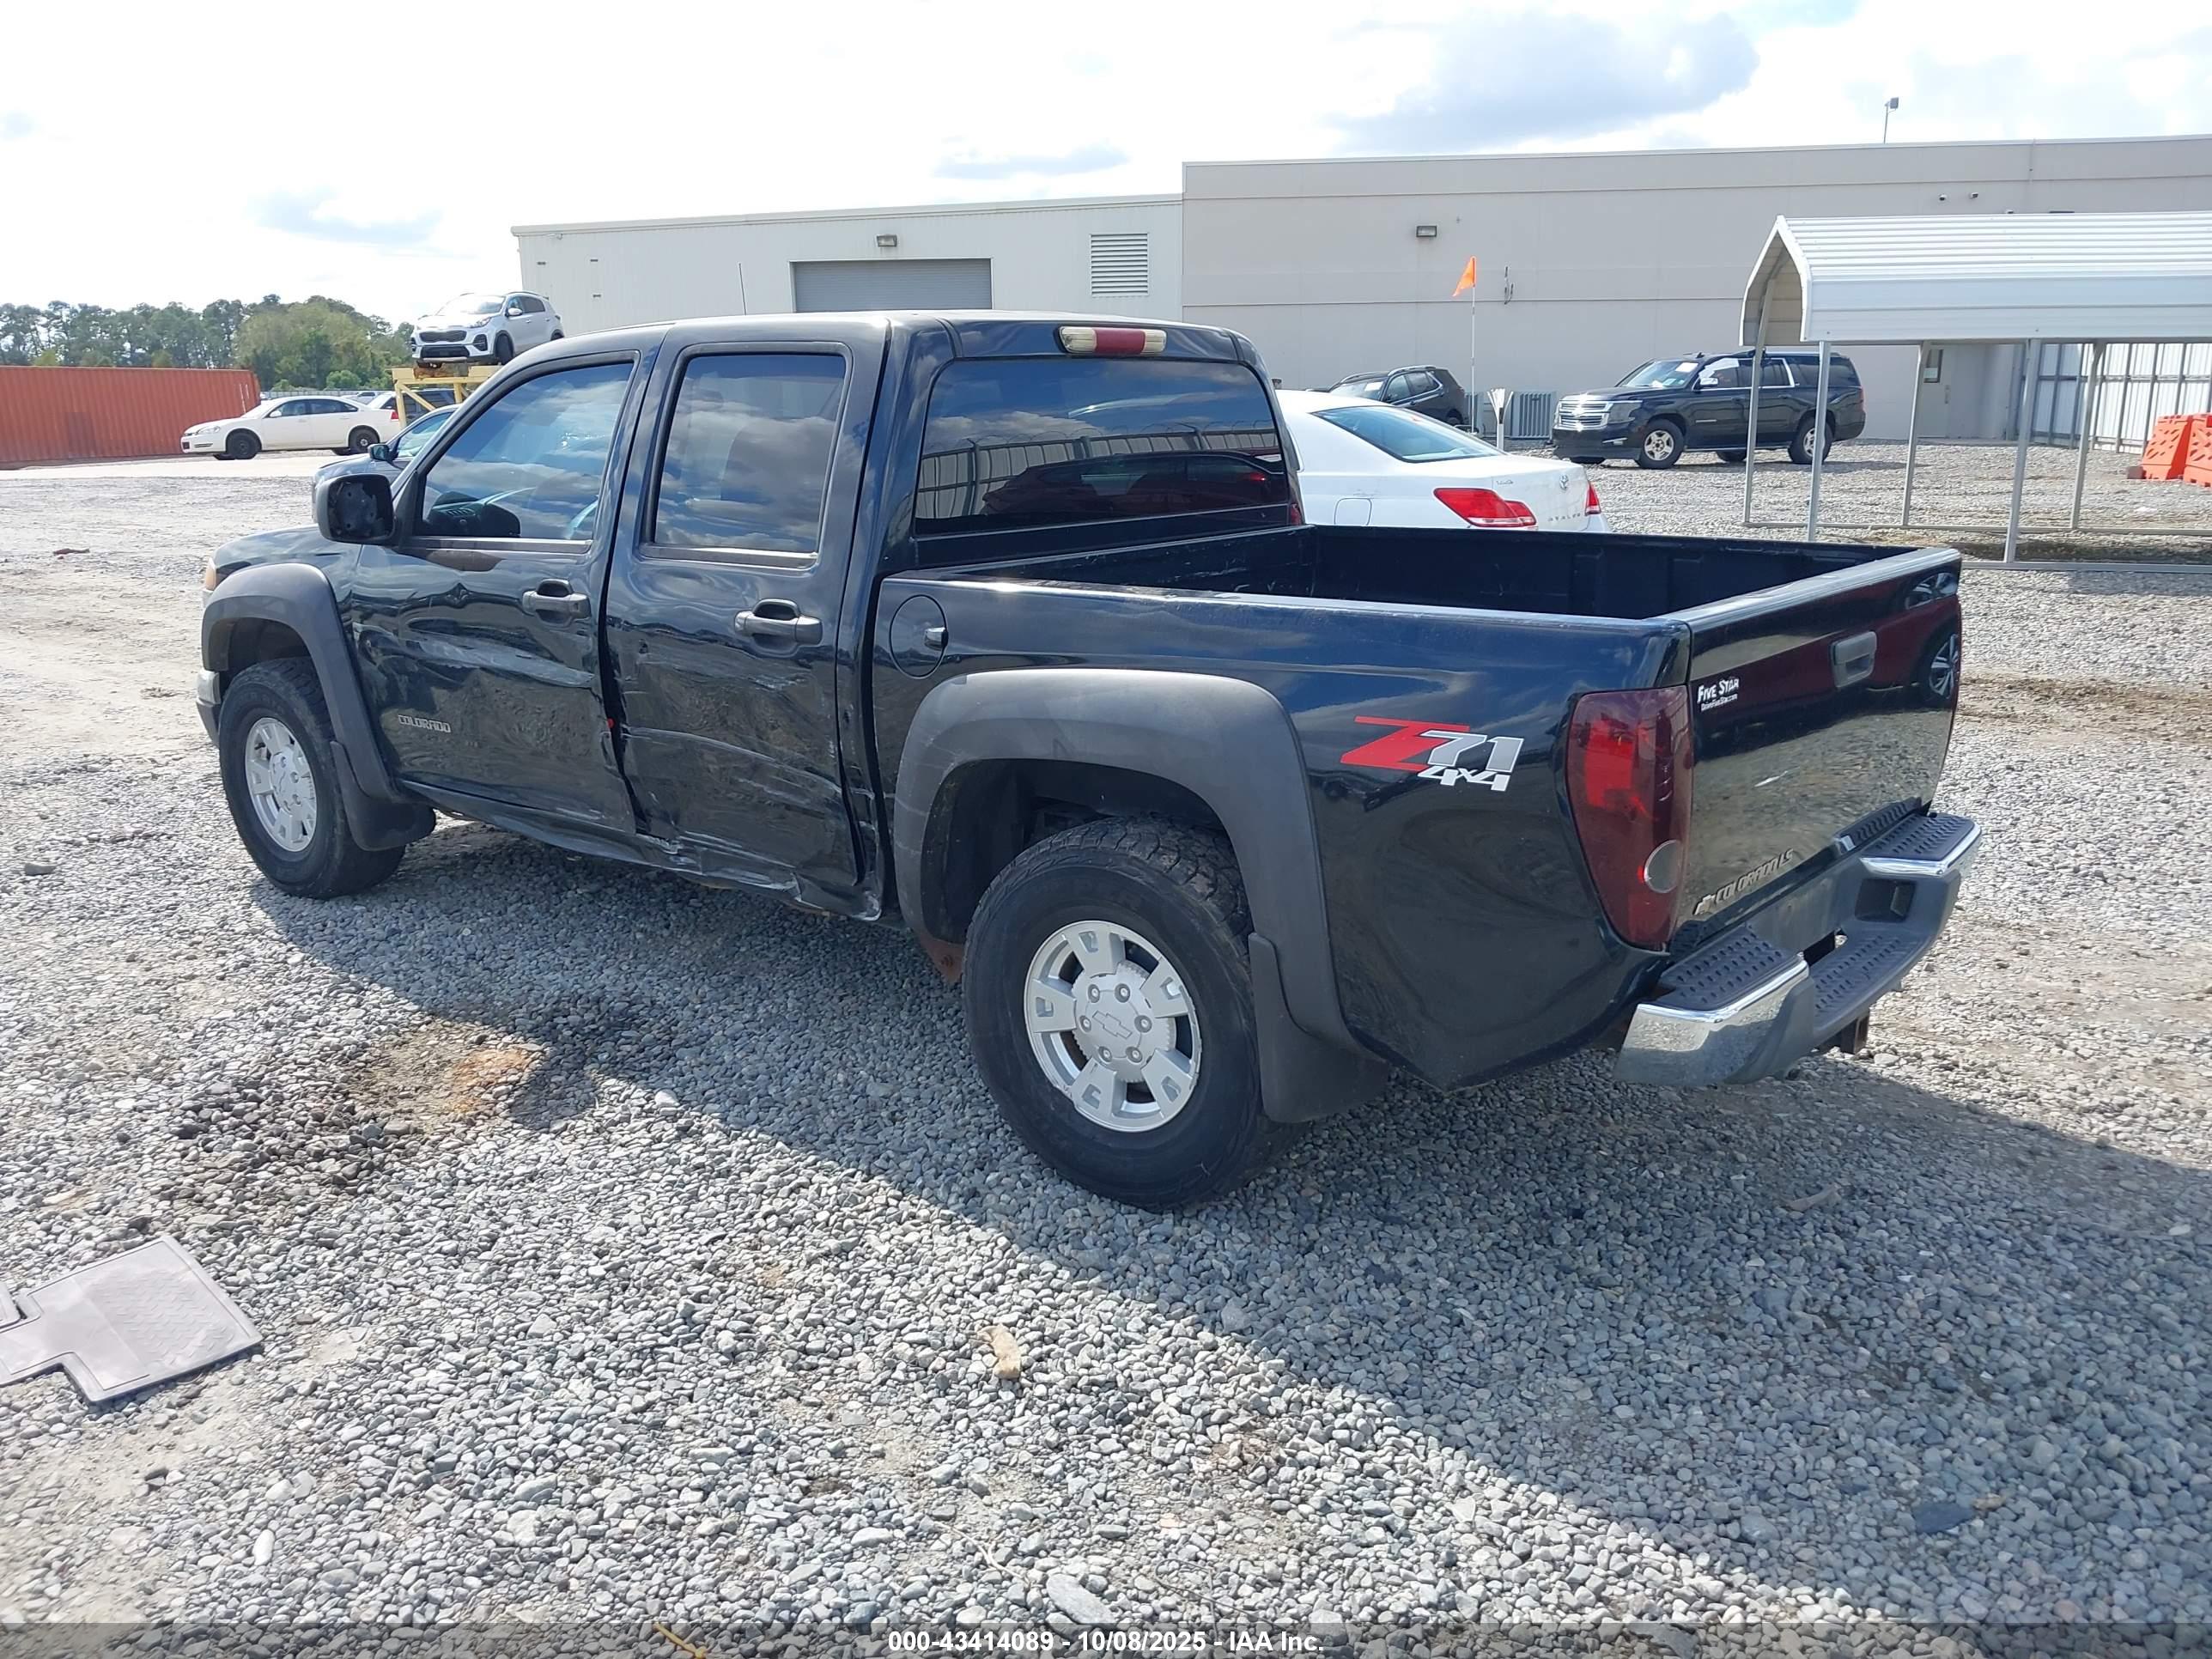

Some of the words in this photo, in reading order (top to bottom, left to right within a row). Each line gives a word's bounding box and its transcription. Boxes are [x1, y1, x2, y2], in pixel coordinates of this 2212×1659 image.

[398, 714, 452, 733] COLORADO
[1340, 715, 1524, 773] Z71
[1715, 856, 1779, 904] COLORADO
